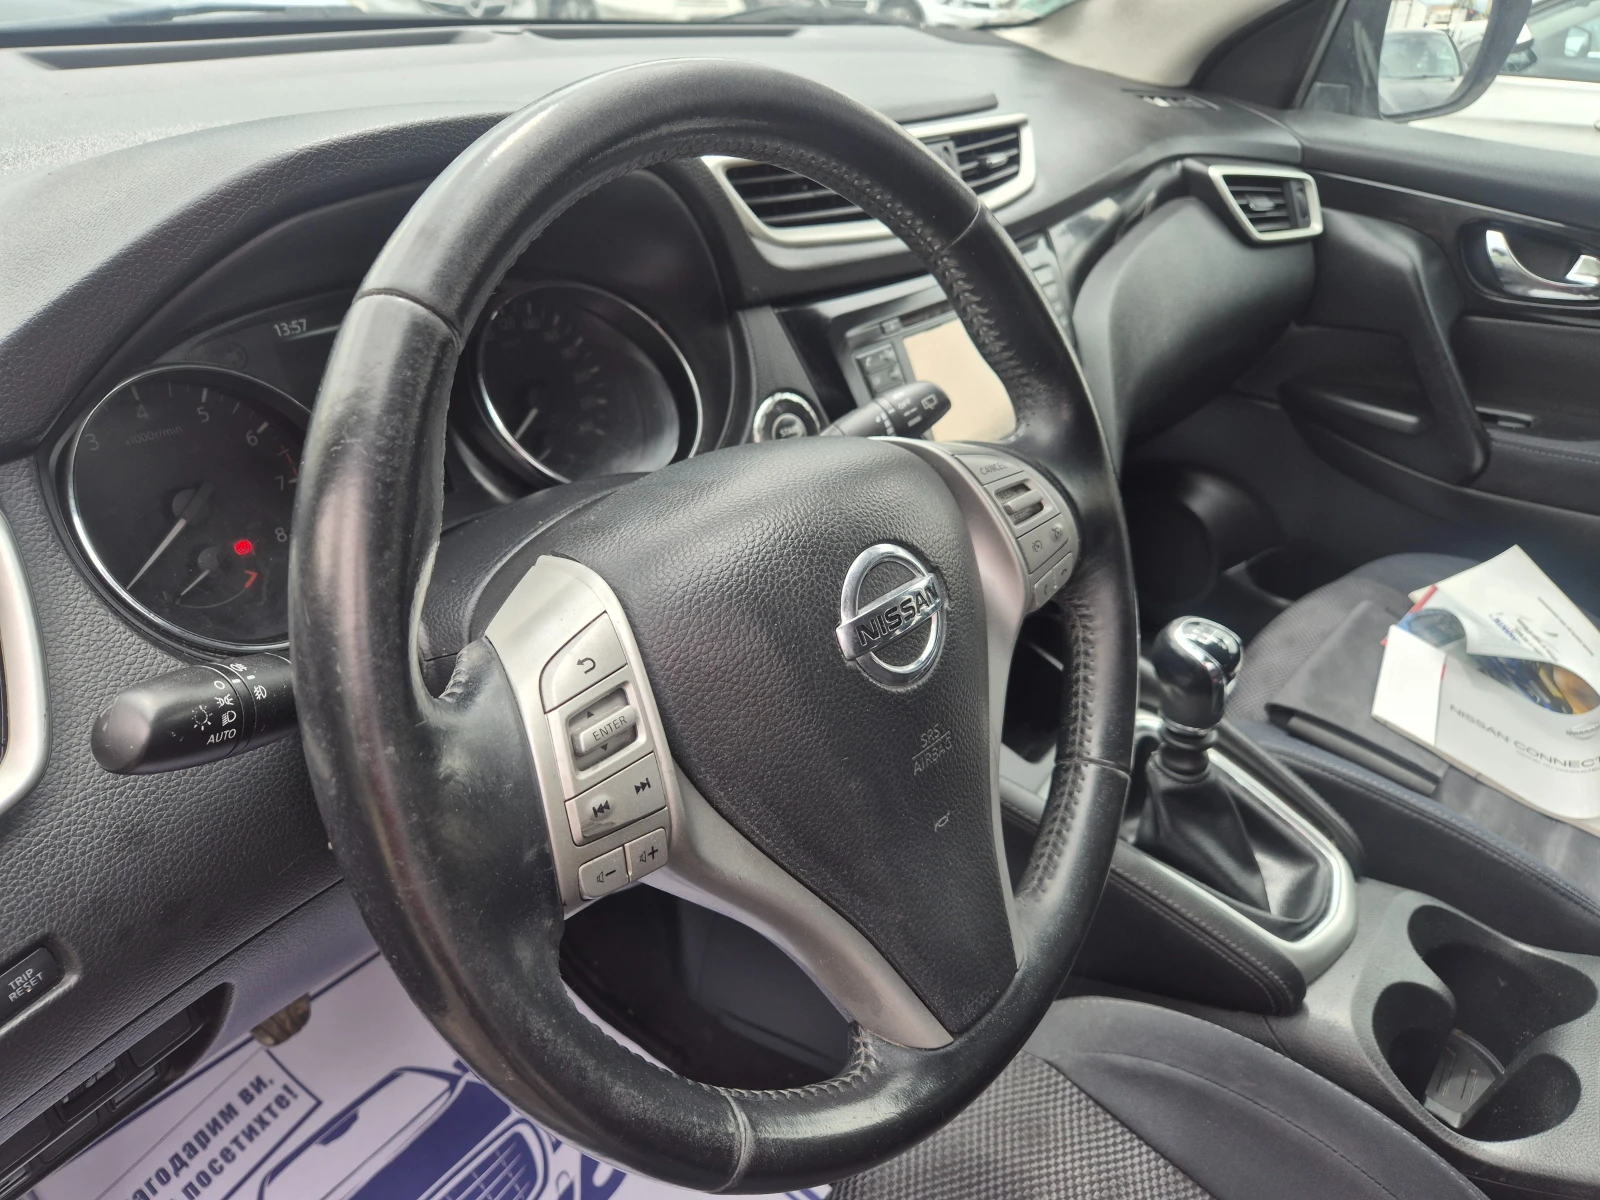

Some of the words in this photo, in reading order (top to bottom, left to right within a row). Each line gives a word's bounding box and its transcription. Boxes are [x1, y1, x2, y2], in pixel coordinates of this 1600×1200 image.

[273, 319, 308, 338] 13:57
[137, 404, 149, 420] 4
[196, 407, 210, 423] 5
[84, 433, 99, 451] 3
[246, 431, 259, 447] 6
[979, 461, 1008, 476] CANCEL
[275, 475, 285, 491] 7
[275, 527, 287, 542] 8
[854, 581, 940, 647] NISSAN
[591, 714, 629, 742] ENTER
[1449, 704, 1509, 742] NISSAN
[206, 728, 237, 746] AUTO
[920, 723, 940, 748] SRS
[913, 736, 952, 776] AIRBAG
[8, 968, 33, 990] TRIP
[8, 971, 43, 1002] RESET
[181, 1083, 299, 1200] посетихте!
